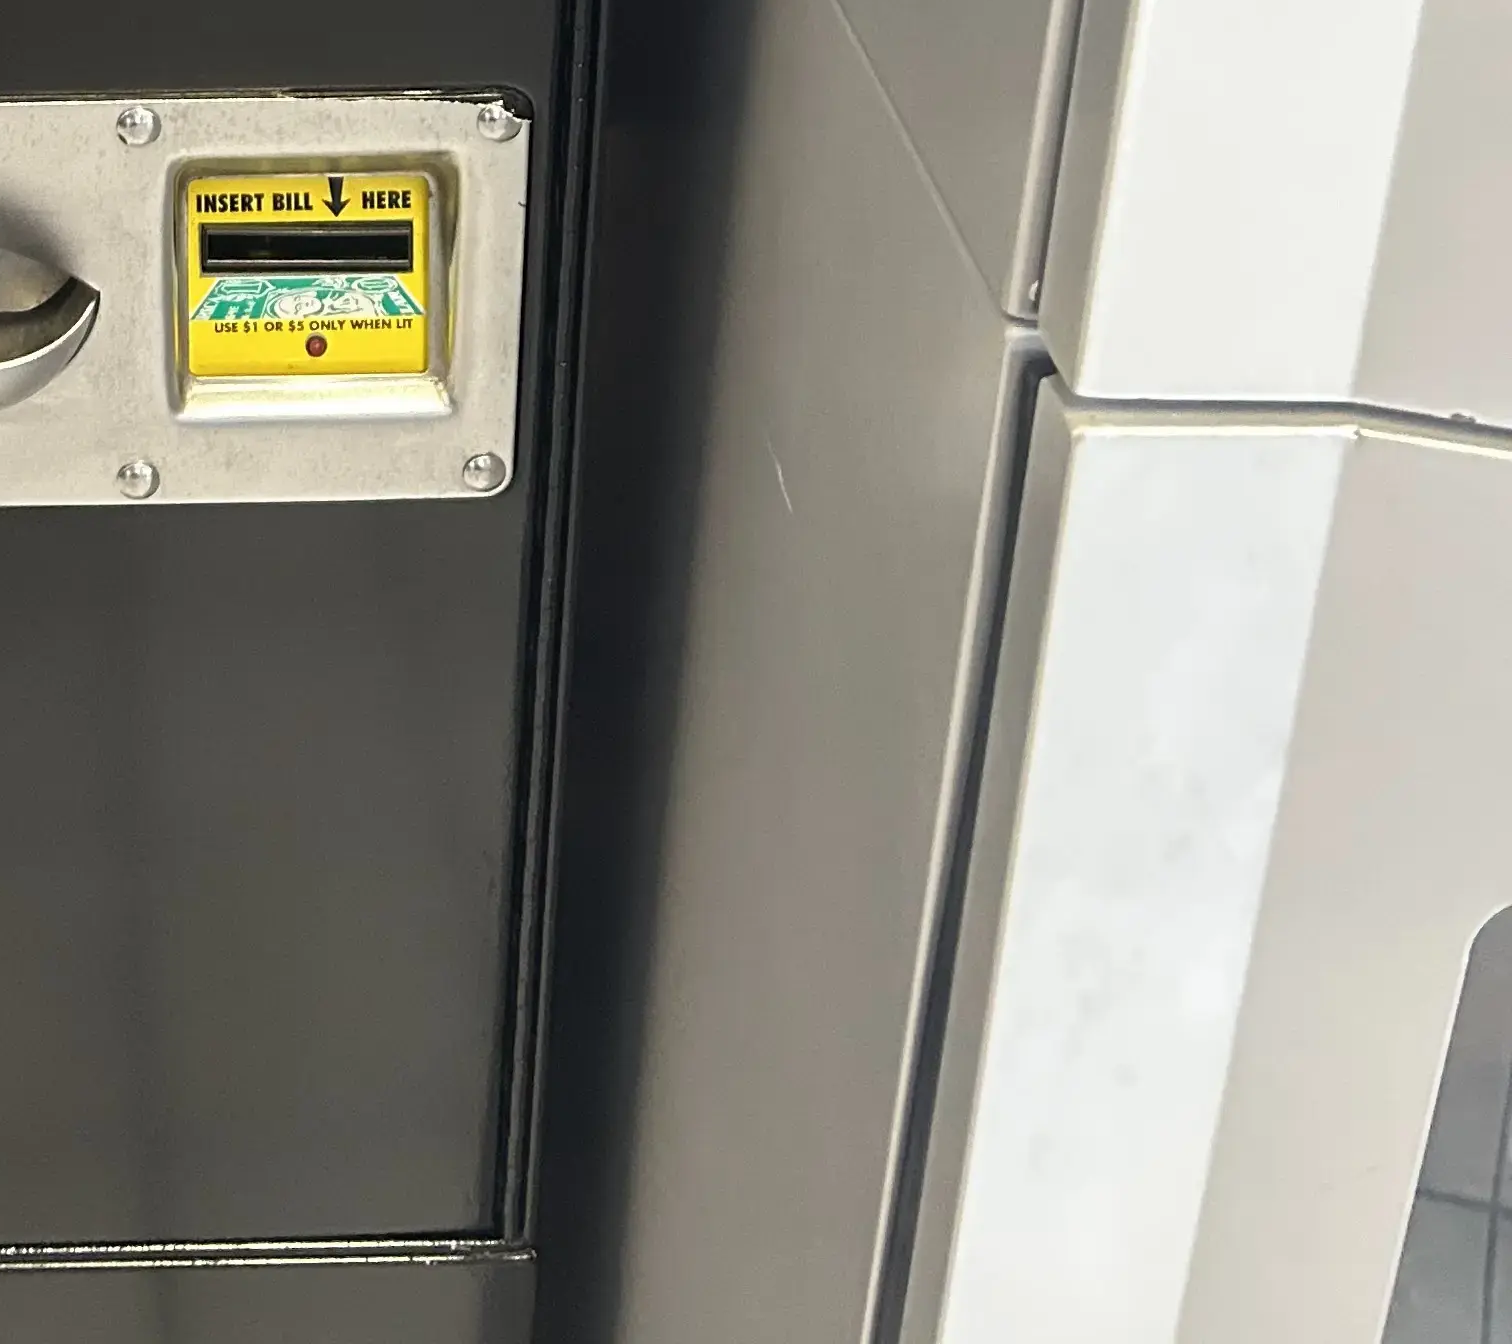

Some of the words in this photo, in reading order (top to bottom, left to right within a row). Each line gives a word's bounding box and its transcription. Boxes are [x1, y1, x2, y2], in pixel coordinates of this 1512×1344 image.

[196, 193, 264, 213] INSERT
[272, 192, 313, 212] BILL
[361, 190, 411, 209] HERE
[214, 322, 238, 332] USE
[243, 321, 257, 333] $1
[264, 320, 283, 331] OR
[288, 319, 305, 331] $5
[309, 320, 346, 331] ONLY
[350, 319, 391, 330] WHEN
[396, 318, 413, 329] LIT
